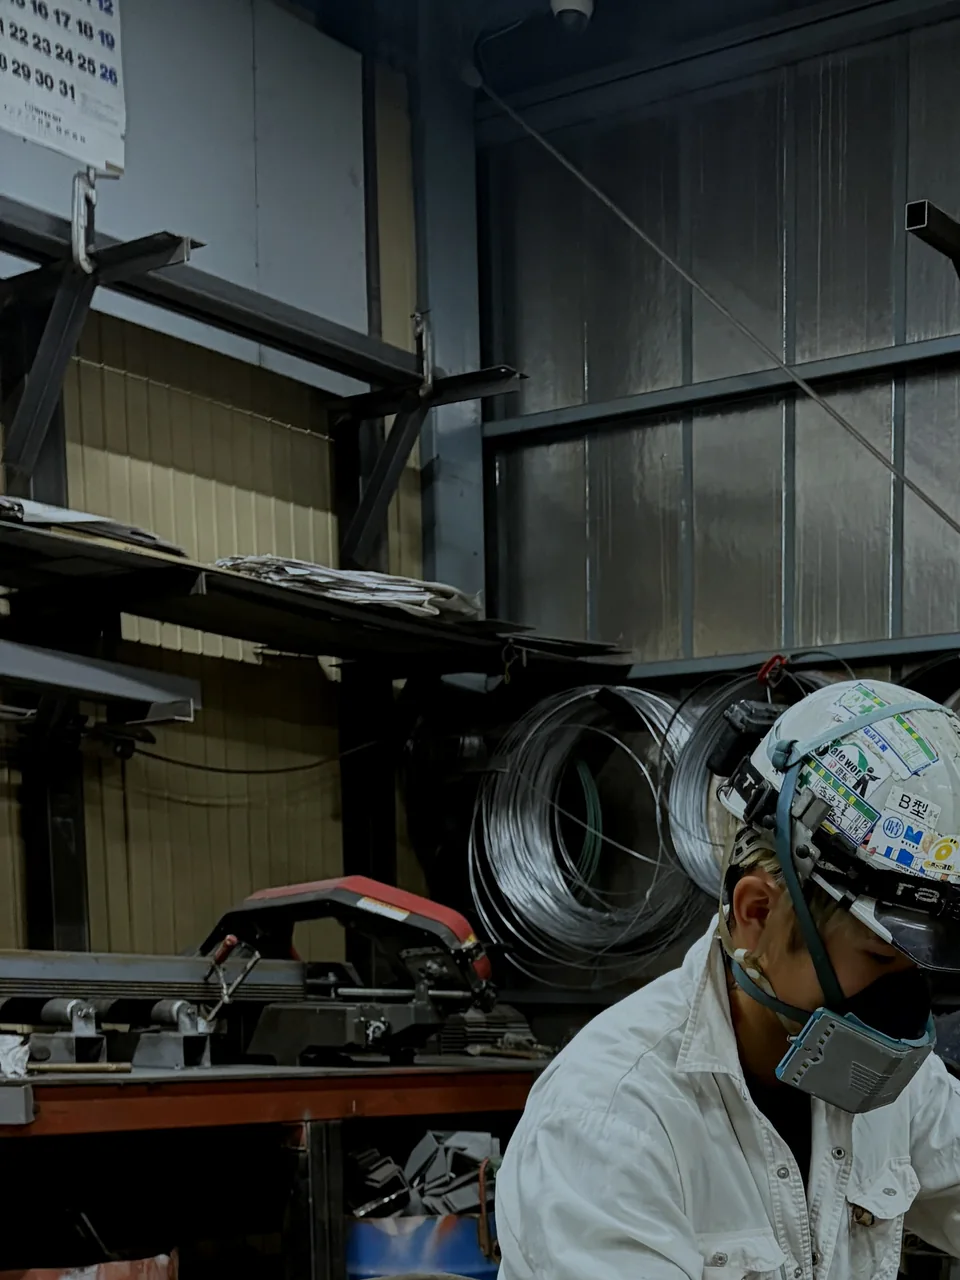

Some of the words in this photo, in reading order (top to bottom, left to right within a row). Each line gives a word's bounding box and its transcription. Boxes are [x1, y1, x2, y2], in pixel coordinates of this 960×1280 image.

[53, 8, 71, 30] 17
[76, 18, 94, 40] 18
[98, 29, 115, 51] 19
[9, 22, 29, 46] 22
[32, 33, 52, 57] 23
[55, 43, 74, 67] 24
[77, 53, 96, 77] 25
[99, 62, 118, 87] 26
[12, 59, 32, 82] 29
[35, 69, 54, 92] 30
[59, 78, 77, 103] 31
[898, 794, 929, 820] B型
